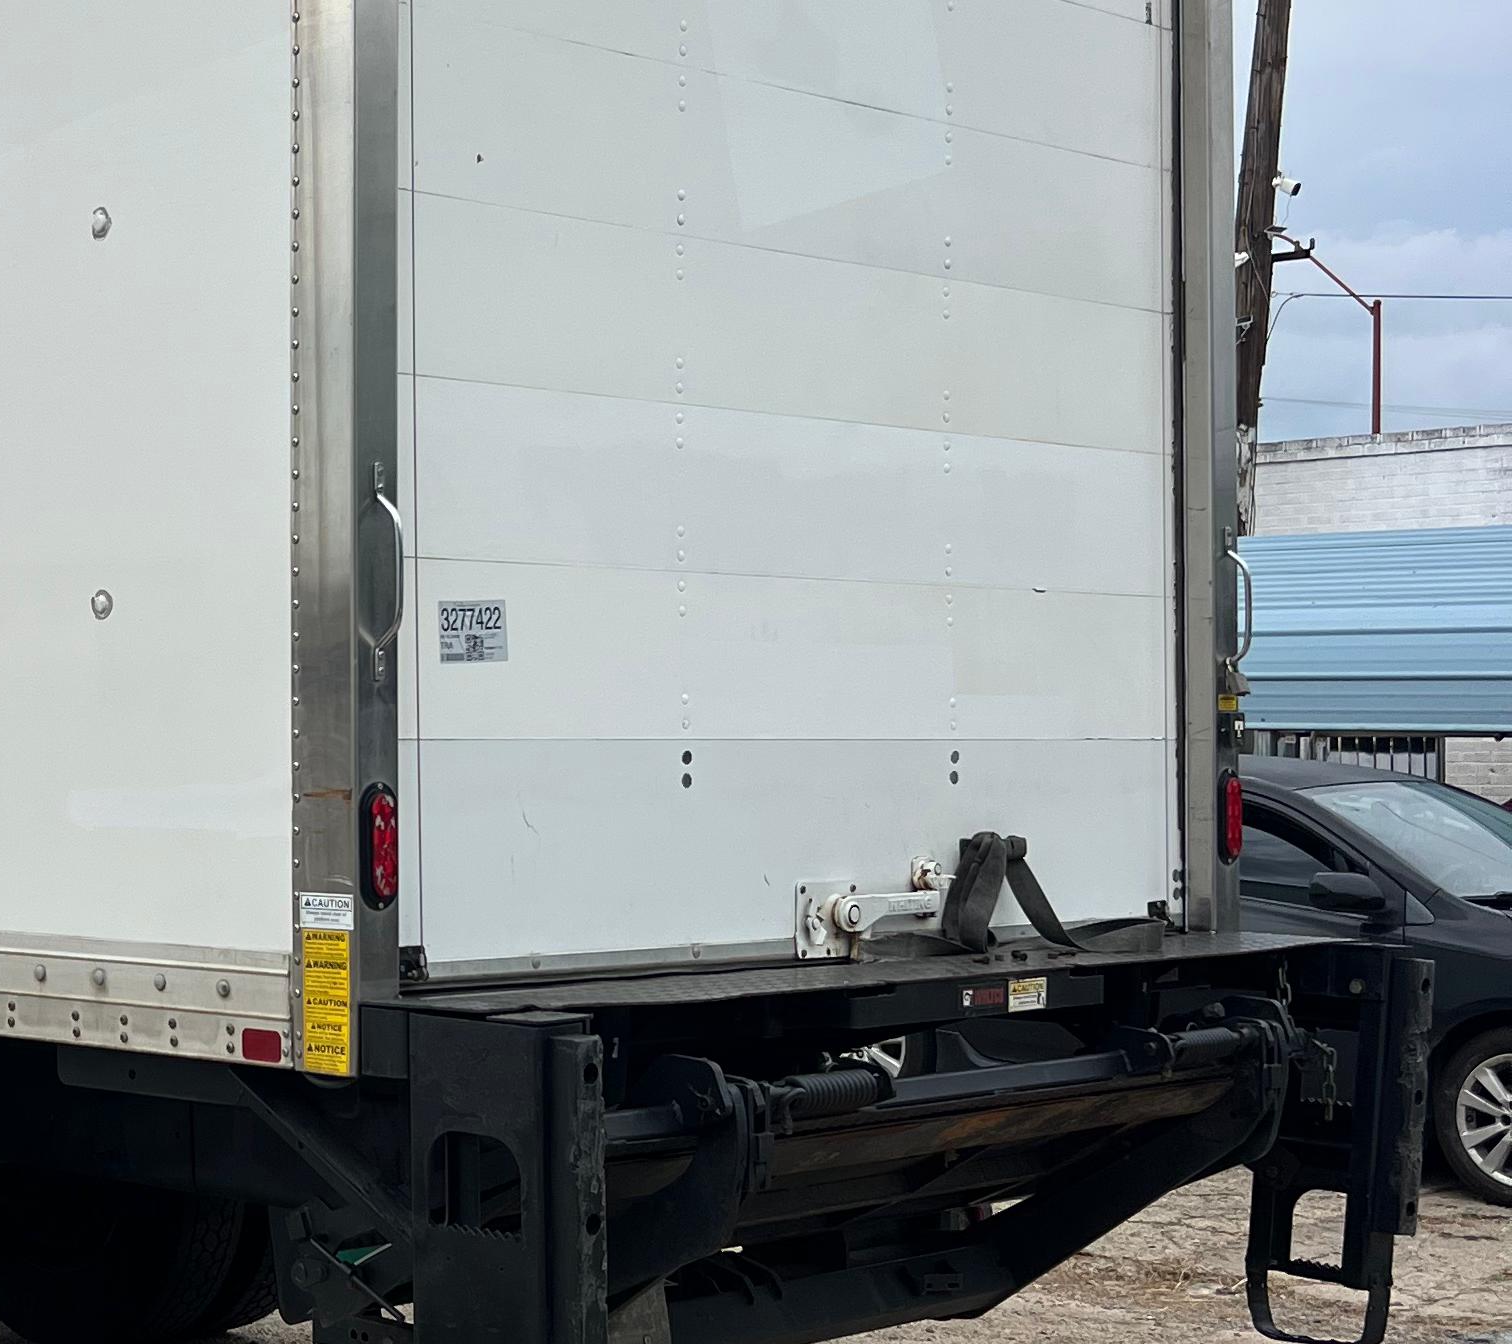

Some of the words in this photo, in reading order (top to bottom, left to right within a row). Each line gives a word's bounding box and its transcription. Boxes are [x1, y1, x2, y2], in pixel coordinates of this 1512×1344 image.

[441, 606, 502, 631] 3277422
[311, 898, 350, 909] CAUTION
[311, 933, 346, 943] WARNING
[312, 960, 348, 971] WARNING
[312, 997, 348, 1007] CAUTION
[316, 1023, 342, 1032] NOTICE
[314, 1044, 346, 1055] NOTICE
